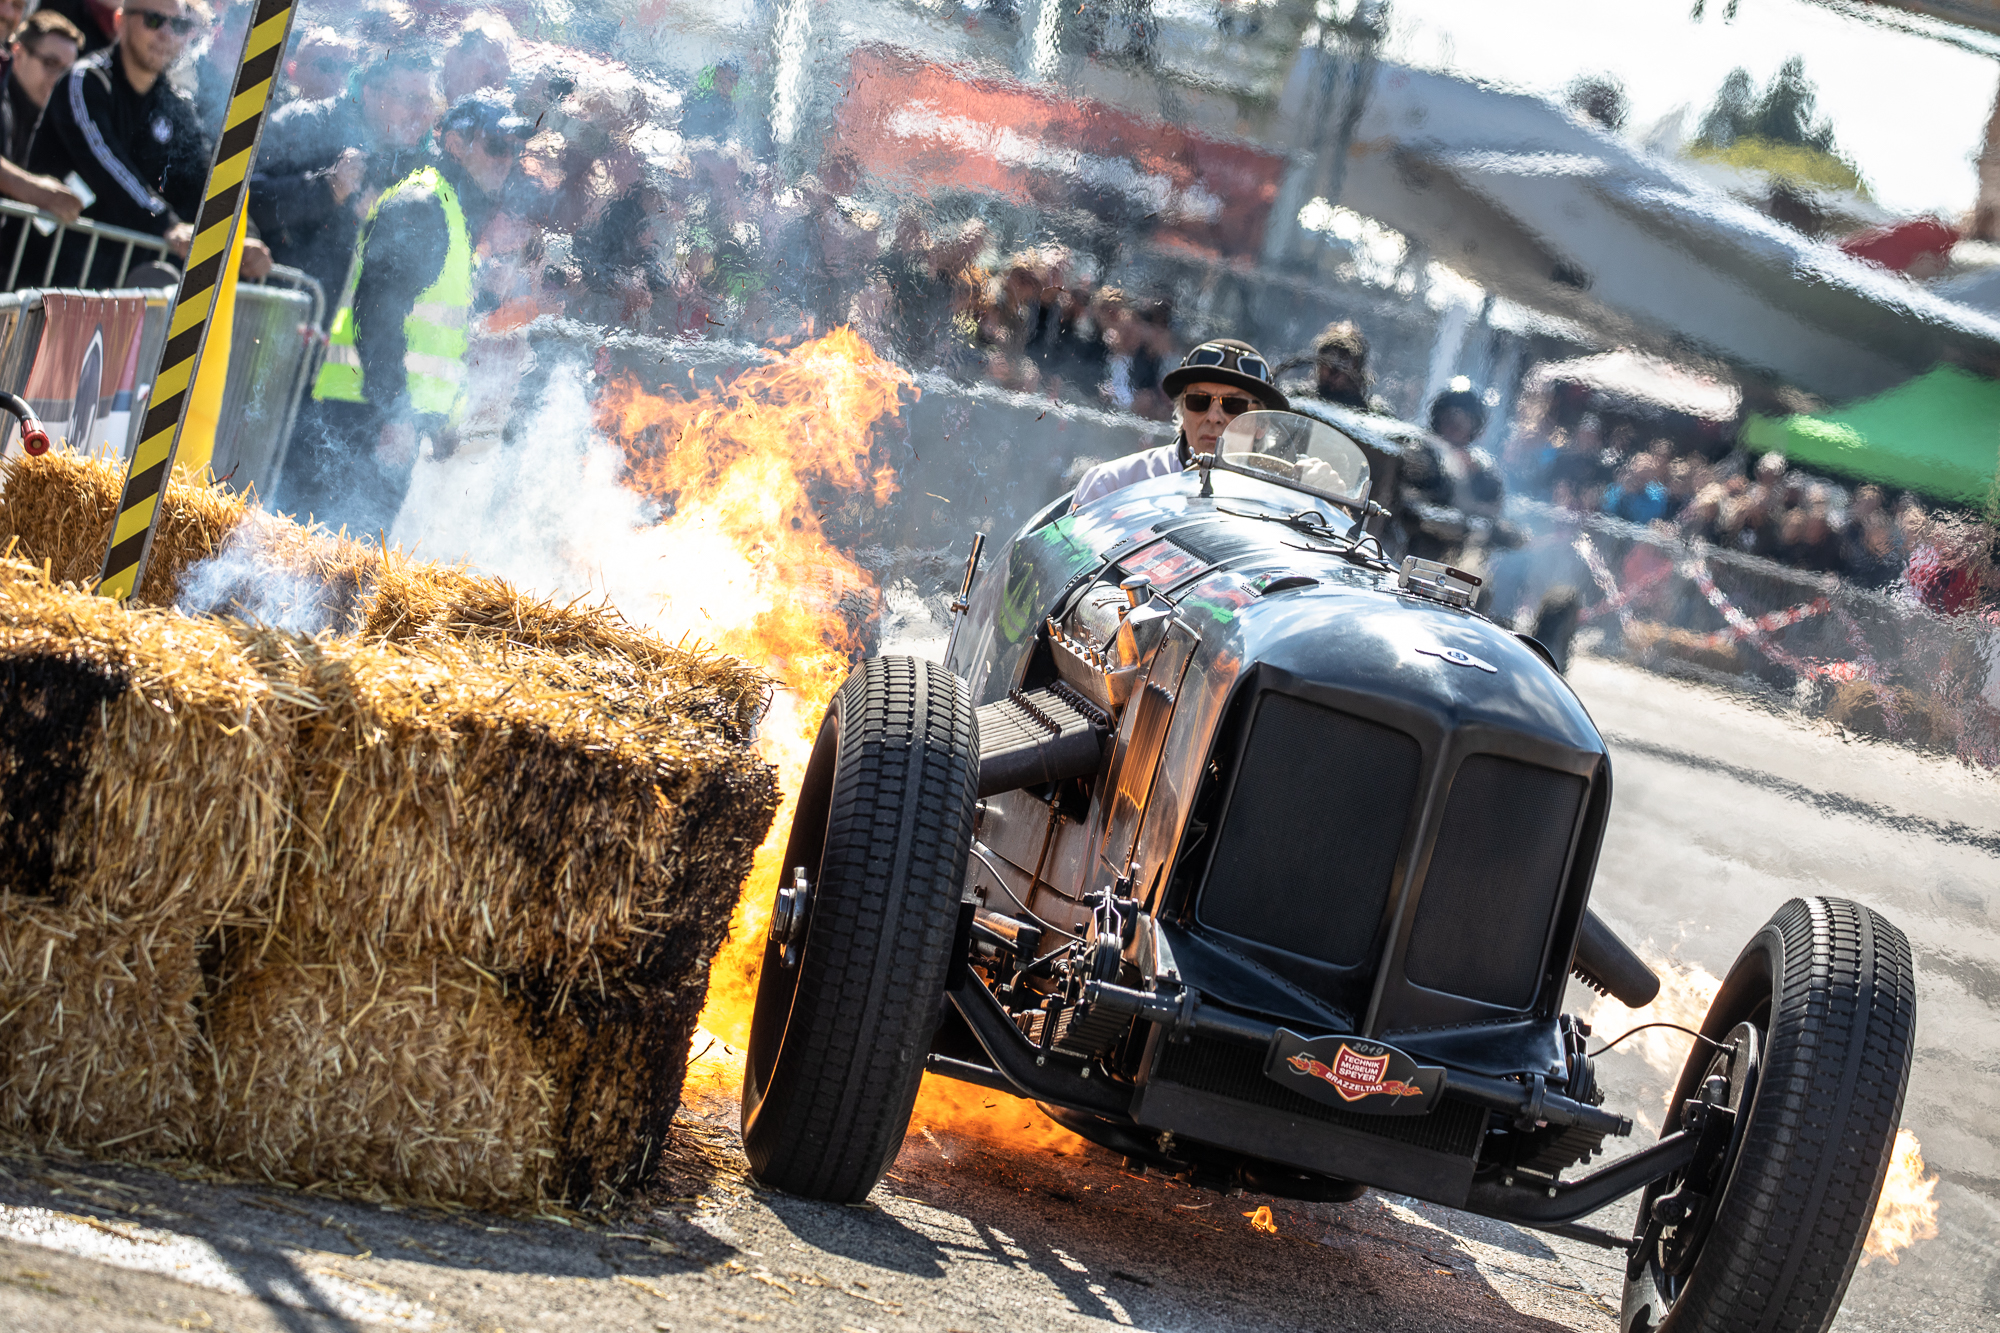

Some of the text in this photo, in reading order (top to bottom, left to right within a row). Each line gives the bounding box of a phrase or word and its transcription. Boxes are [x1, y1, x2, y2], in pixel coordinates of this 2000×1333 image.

[1353, 1042, 1384, 1056] 2019
[1340, 1061, 1379, 1076] MUSEUM
[1344, 1054, 1380, 1069] TECHNIK
[1338, 1067, 1376, 1082] SPEYER
